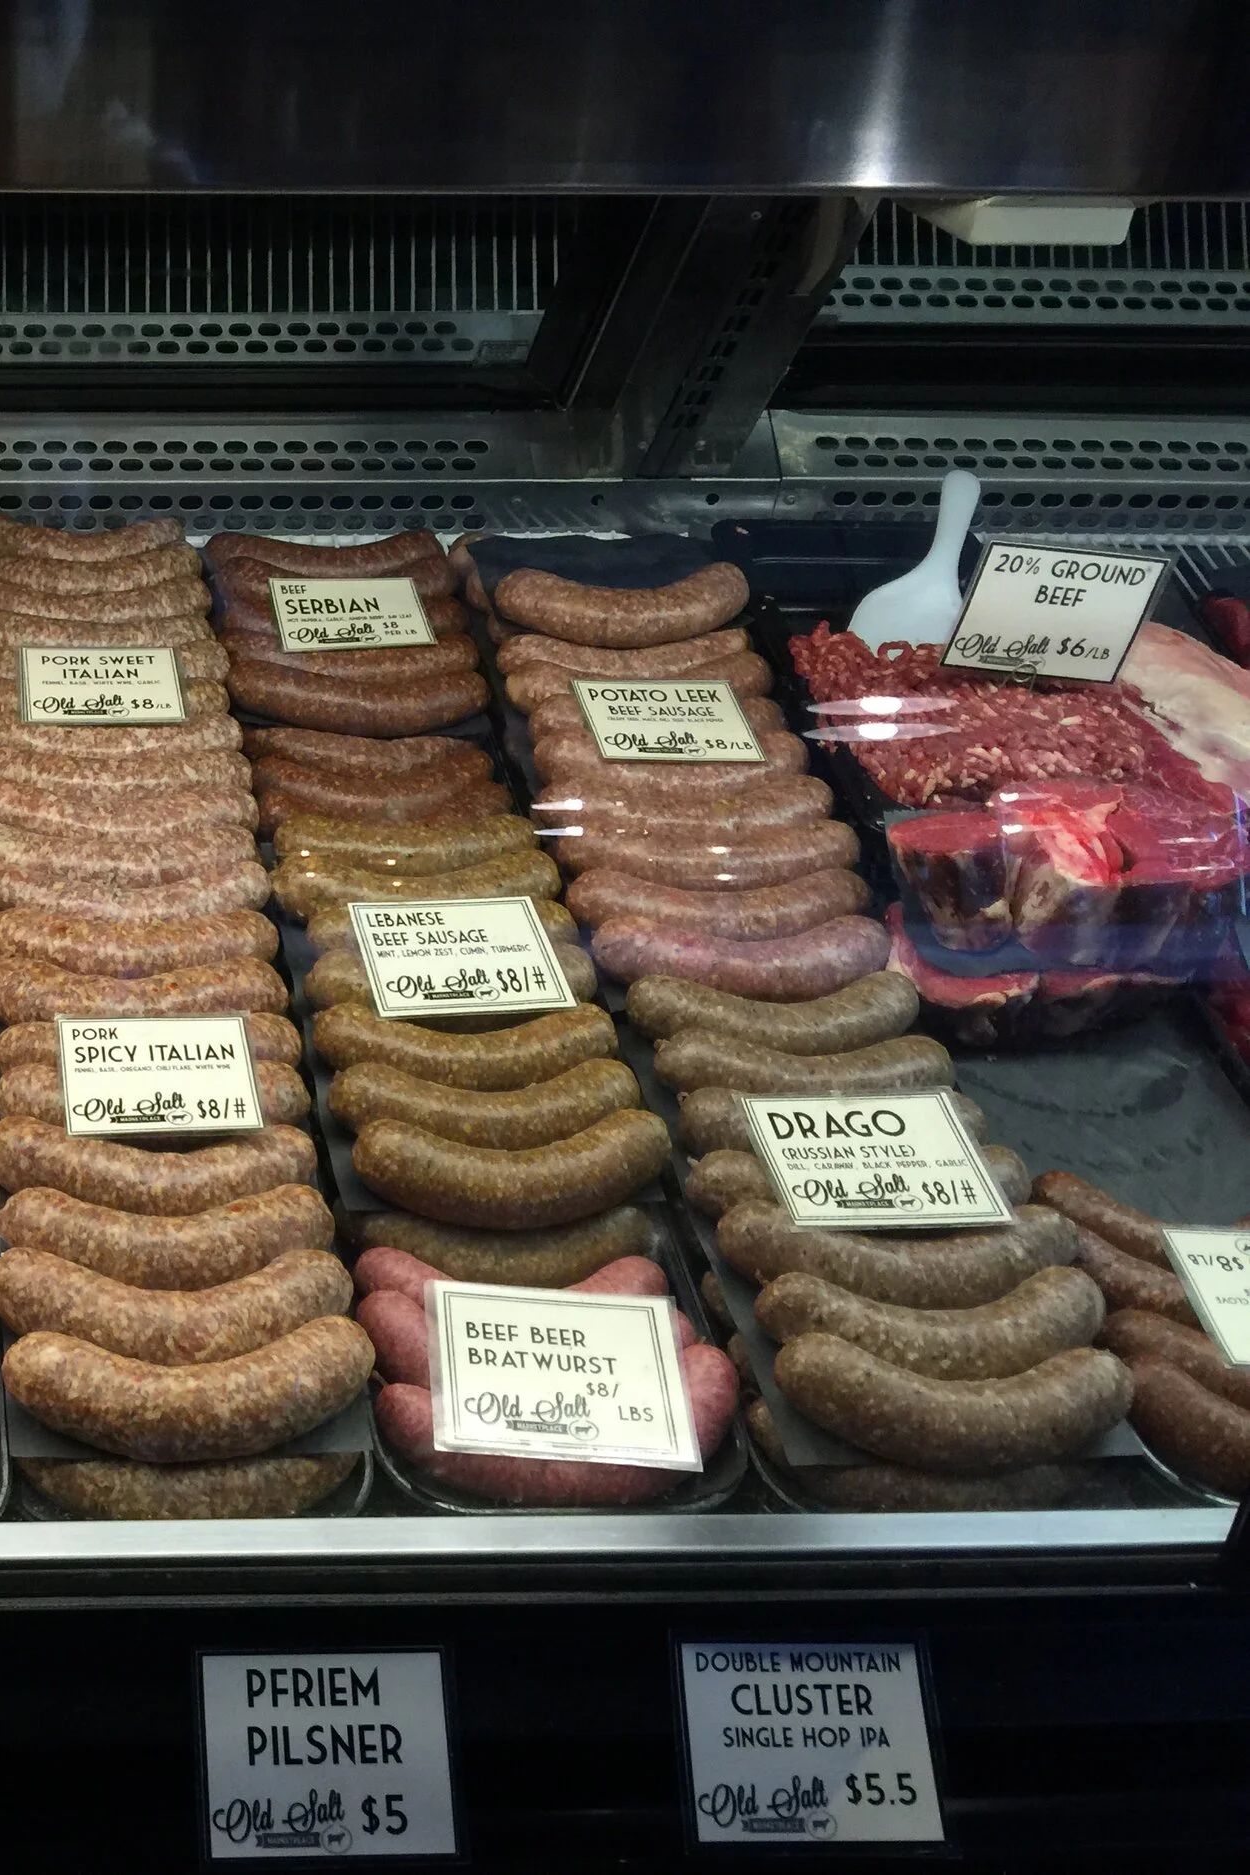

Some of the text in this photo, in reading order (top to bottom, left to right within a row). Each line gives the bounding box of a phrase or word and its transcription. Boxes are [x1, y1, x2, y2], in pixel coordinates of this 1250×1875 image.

[994, 553, 1146, 586] 20% GROUND
[281, 585, 307, 594] BEEF
[1034, 584, 1087, 608] BEEF
[285, 597, 380, 615] SERBIAN
[288, 627, 329, 643] Old
[335, 623, 375, 637] Salt
[954, 633, 1001, 659] Old
[1003, 634, 1050, 659] Salt
[41, 655, 155, 665] PORK SWEET
[62, 668, 139, 679] ITALIAN
[33, 697, 75, 713] Old
[82, 694, 124, 710] Salt
[588, 688, 722, 703] POTATO LEEK
[608, 706, 716, 717] BEEF SAUSAGE
[604, 732, 648, 750] Old
[654, 731, 698, 748] Salt
[366, 912, 445, 927] LEBANESE
[372, 929, 489, 946] BEEF SAUSAGE
[386, 975, 435, 998] Old
[442, 968, 490, 991] Salt
[72, 1027, 118, 1040] PORK
[75, 1044, 235, 1063] SPICY ITALIAN
[73, 1098, 125, 1121] Old
[132, 1092, 186, 1115] Salt
[767, 1109, 906, 1140] DRAGO
[782, 1144, 917, 1160] (RUSSIAN STYLE)
[862, 1161, 891, 1169] BLACK
[792, 1178, 849, 1206] Old
[855, 1173, 910, 1199] Salt
[465, 1321, 586, 1348] BEEF BEER
[468, 1347, 617, 1376] BRATWURST
[586, 1382, 619, 1398] $8/
[464, 1391, 654, 1424] Old Salt LBS
[696, 1651, 901, 1673] DOUBLE MOUNTAIN
[246, 1665, 380, 1708] PFRIEM
[731, 1683, 874, 1716] CLUSTER
[247, 1723, 403, 1766] PILSNER
[722, 1726, 891, 1748] SINGLE HOP IPA
[698, 1773, 917, 1828] Old Salt $5.5
[212, 1788, 408, 1843] Old Salt $5
